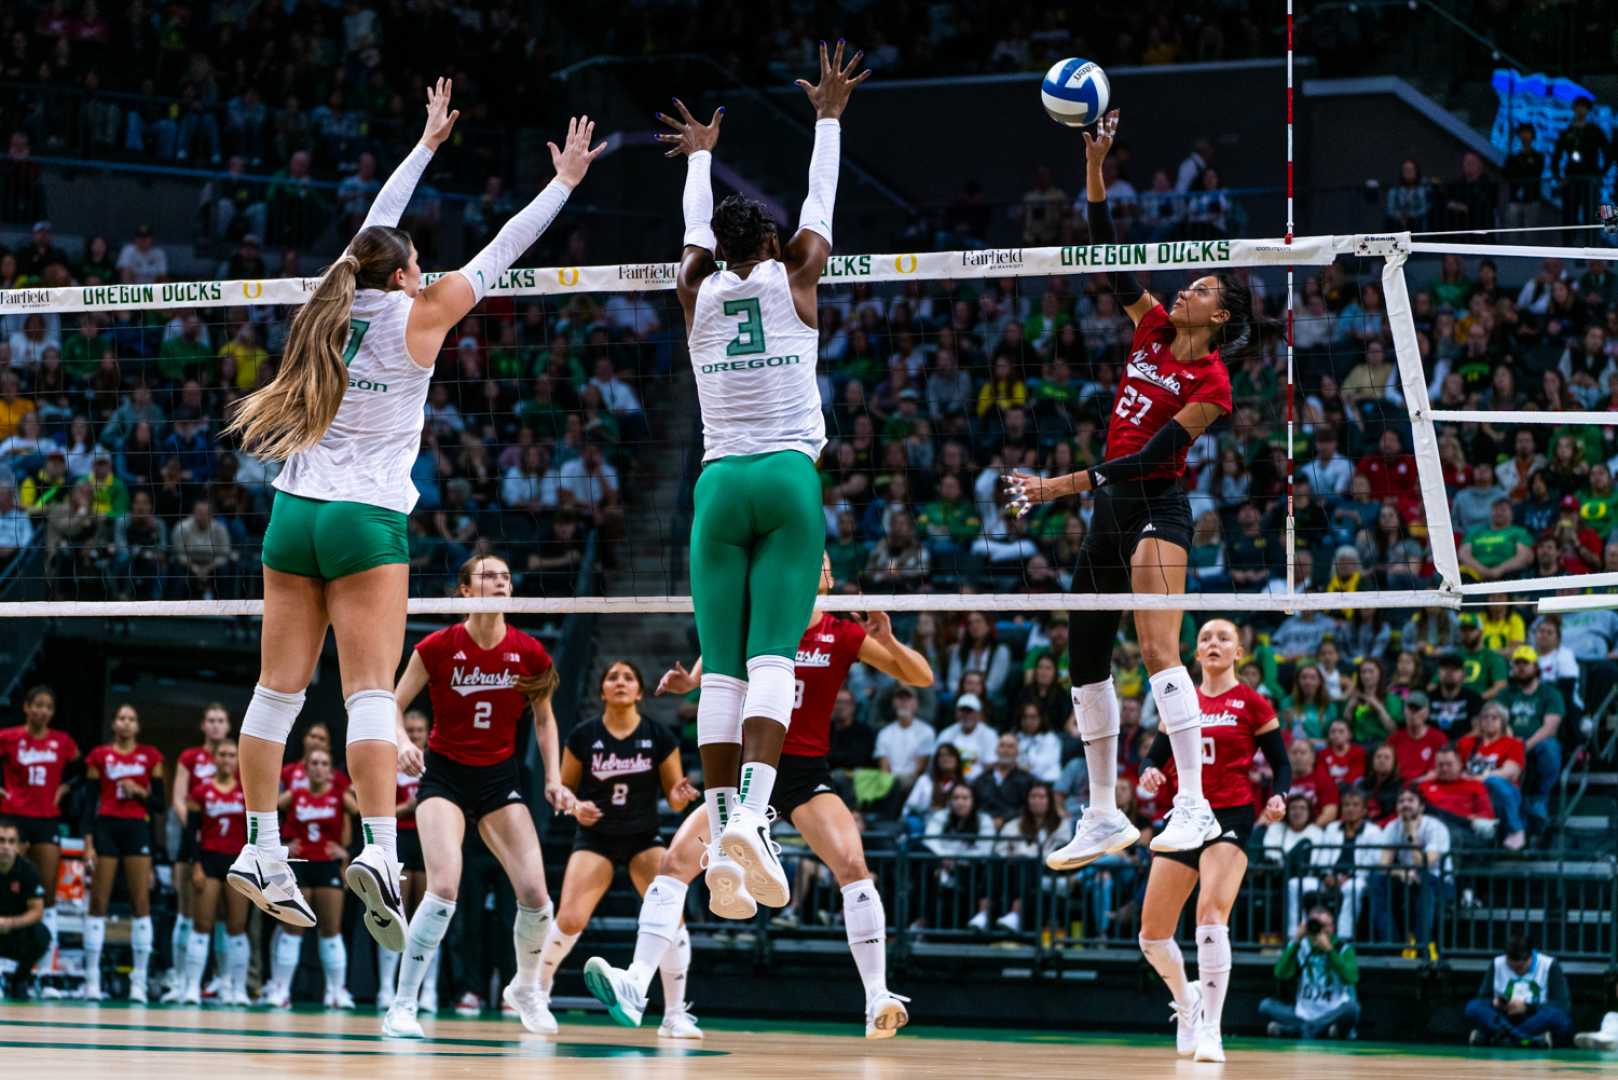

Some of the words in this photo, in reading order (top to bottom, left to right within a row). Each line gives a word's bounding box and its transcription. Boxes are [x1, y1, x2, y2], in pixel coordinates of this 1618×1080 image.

[962, 250, 1023, 266] Fairfield
[1060, 246, 1146, 266] OREGON
[1158, 240, 1230, 263] DUCKS
[618, 263, 675, 280] Fairfield
[821, 255, 871, 277] CKS
[490, 269, 536, 289] CKS
[0, 289, 50, 305] Fairfield
[83, 284, 154, 305] OREGON
[162, 281, 222, 303] DUCKS
[723, 297, 766, 356] 3
[342, 318, 371, 369] 7
[701, 355, 800, 374] OREGON
[1131, 348, 1180, 395] Nebraska
[1115, 385, 1153, 426] 27
[795, 647, 831, 665] aska
[450, 666, 520, 690] Nebraska
[473, 701, 492, 729] 2
[591, 752, 653, 775] Nebraska
[28, 766, 47, 786] 12
[218, 817, 230, 836] 7
